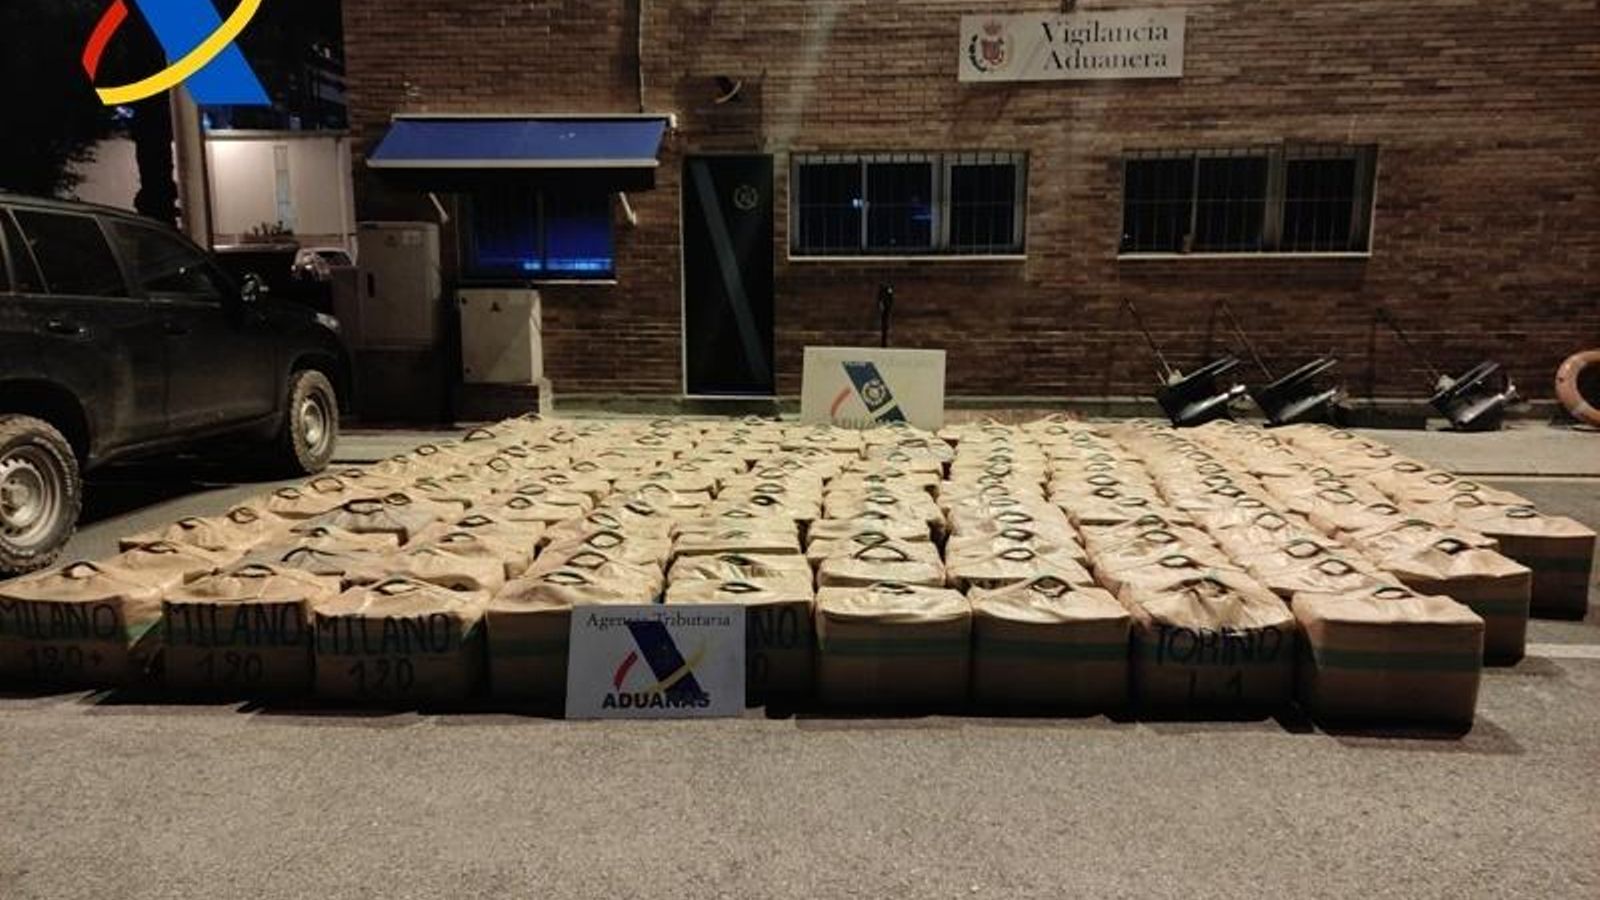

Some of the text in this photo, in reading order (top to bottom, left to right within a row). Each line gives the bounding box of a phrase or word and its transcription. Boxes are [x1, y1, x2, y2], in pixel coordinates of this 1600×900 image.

[1042, 18, 1169, 44] Vigilancia
[1043, 48, 1167, 71] Aduanera
[655, 610, 730, 627] Tributaria
[315, 612, 449, 655] MILANO
[602, 693, 711, 709] ADUANAS
